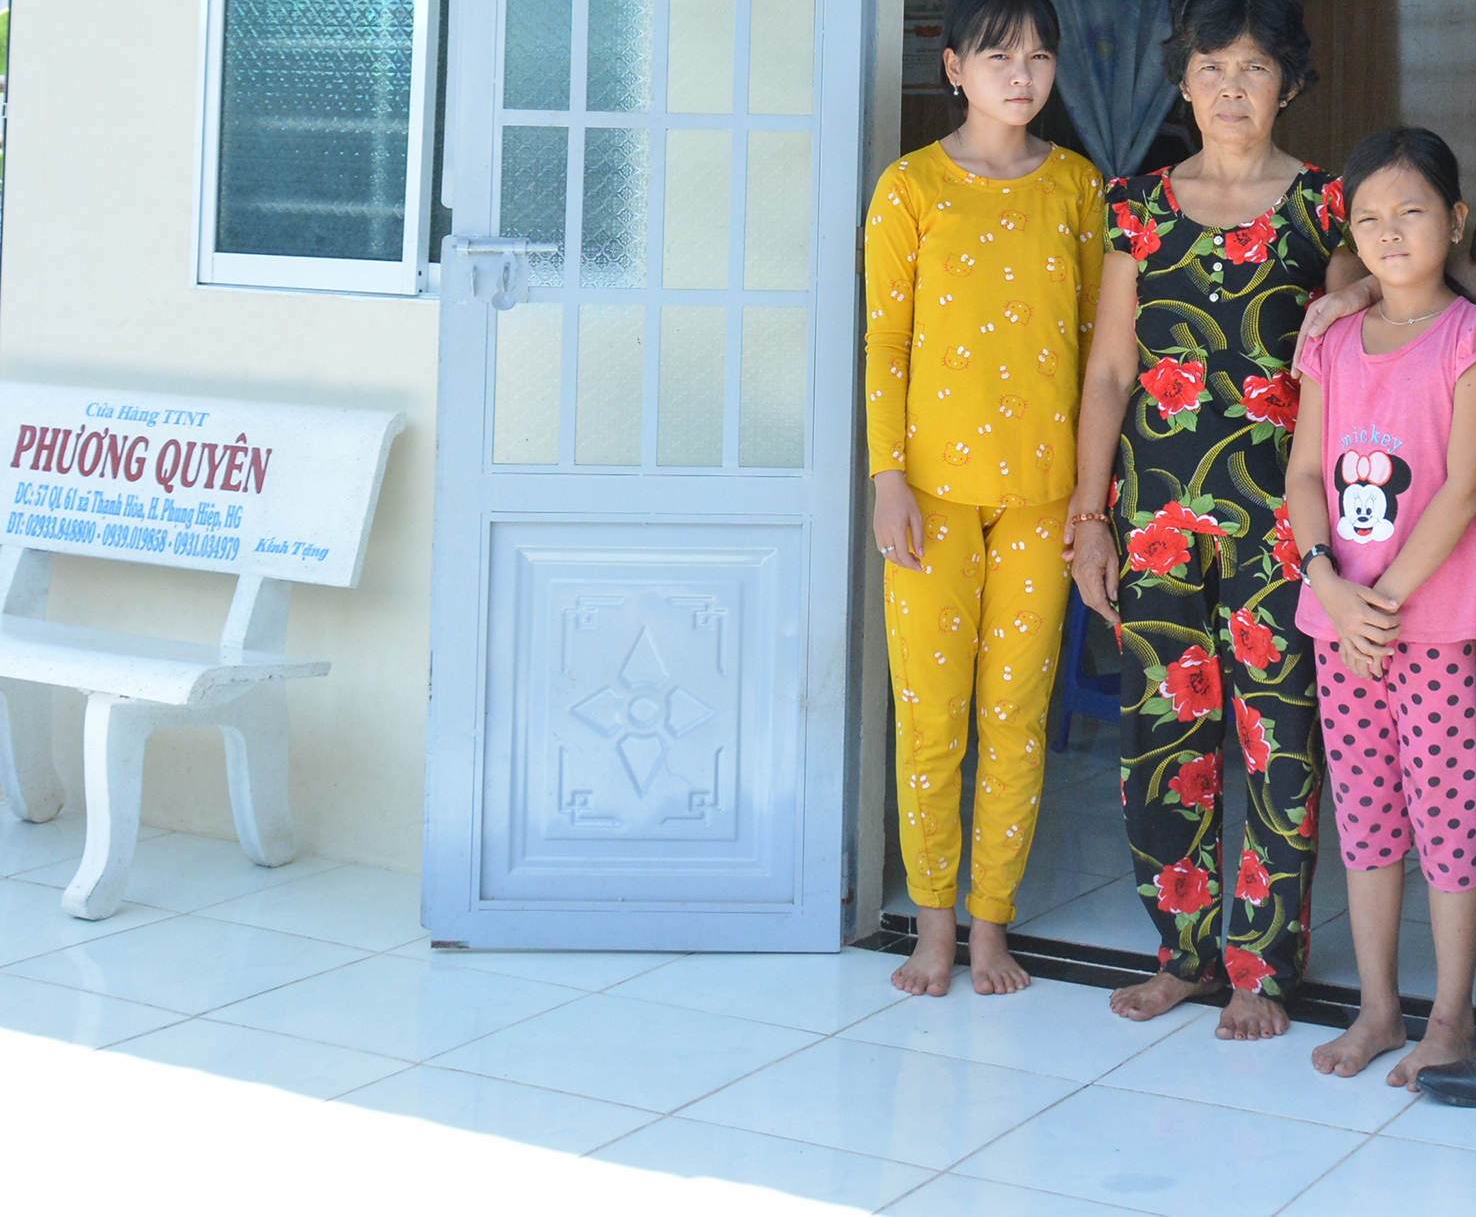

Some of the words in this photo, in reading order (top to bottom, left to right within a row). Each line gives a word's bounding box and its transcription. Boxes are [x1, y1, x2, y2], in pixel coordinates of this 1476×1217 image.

[86, 402, 114, 419] Cửa
[117, 405, 160, 427] Hàng
[163, 409, 209, 428] TTNT
[1341, 423, 1404, 454] mickey
[10, 424, 150, 482] PHƯƠNG
[155, 432, 272, 494] QUYÊN
[14, 481, 34, 505] ĐC:
[34, 484, 49, 507] 57
[48, 485, 63, 512] QL
[63, 487, 77, 511] 61
[76, 490, 92, 513] xã
[91, 490, 123, 520] Thạnh
[123, 494, 145, 521] Hòa,
[147, 496, 160, 520] H.
[160, 498, 195, 530] Phụng
[194, 501, 222, 532] Hiệp,
[223, 504, 243, 530] HG
[6, 511, 25, 535] ĐT:
[102, 523, 168, 553] 0939.019858
[173, 530, 240, 561] 0931.034979
[253, 536, 289, 555] Kính
[291, 541, 330, 562] Tặng
